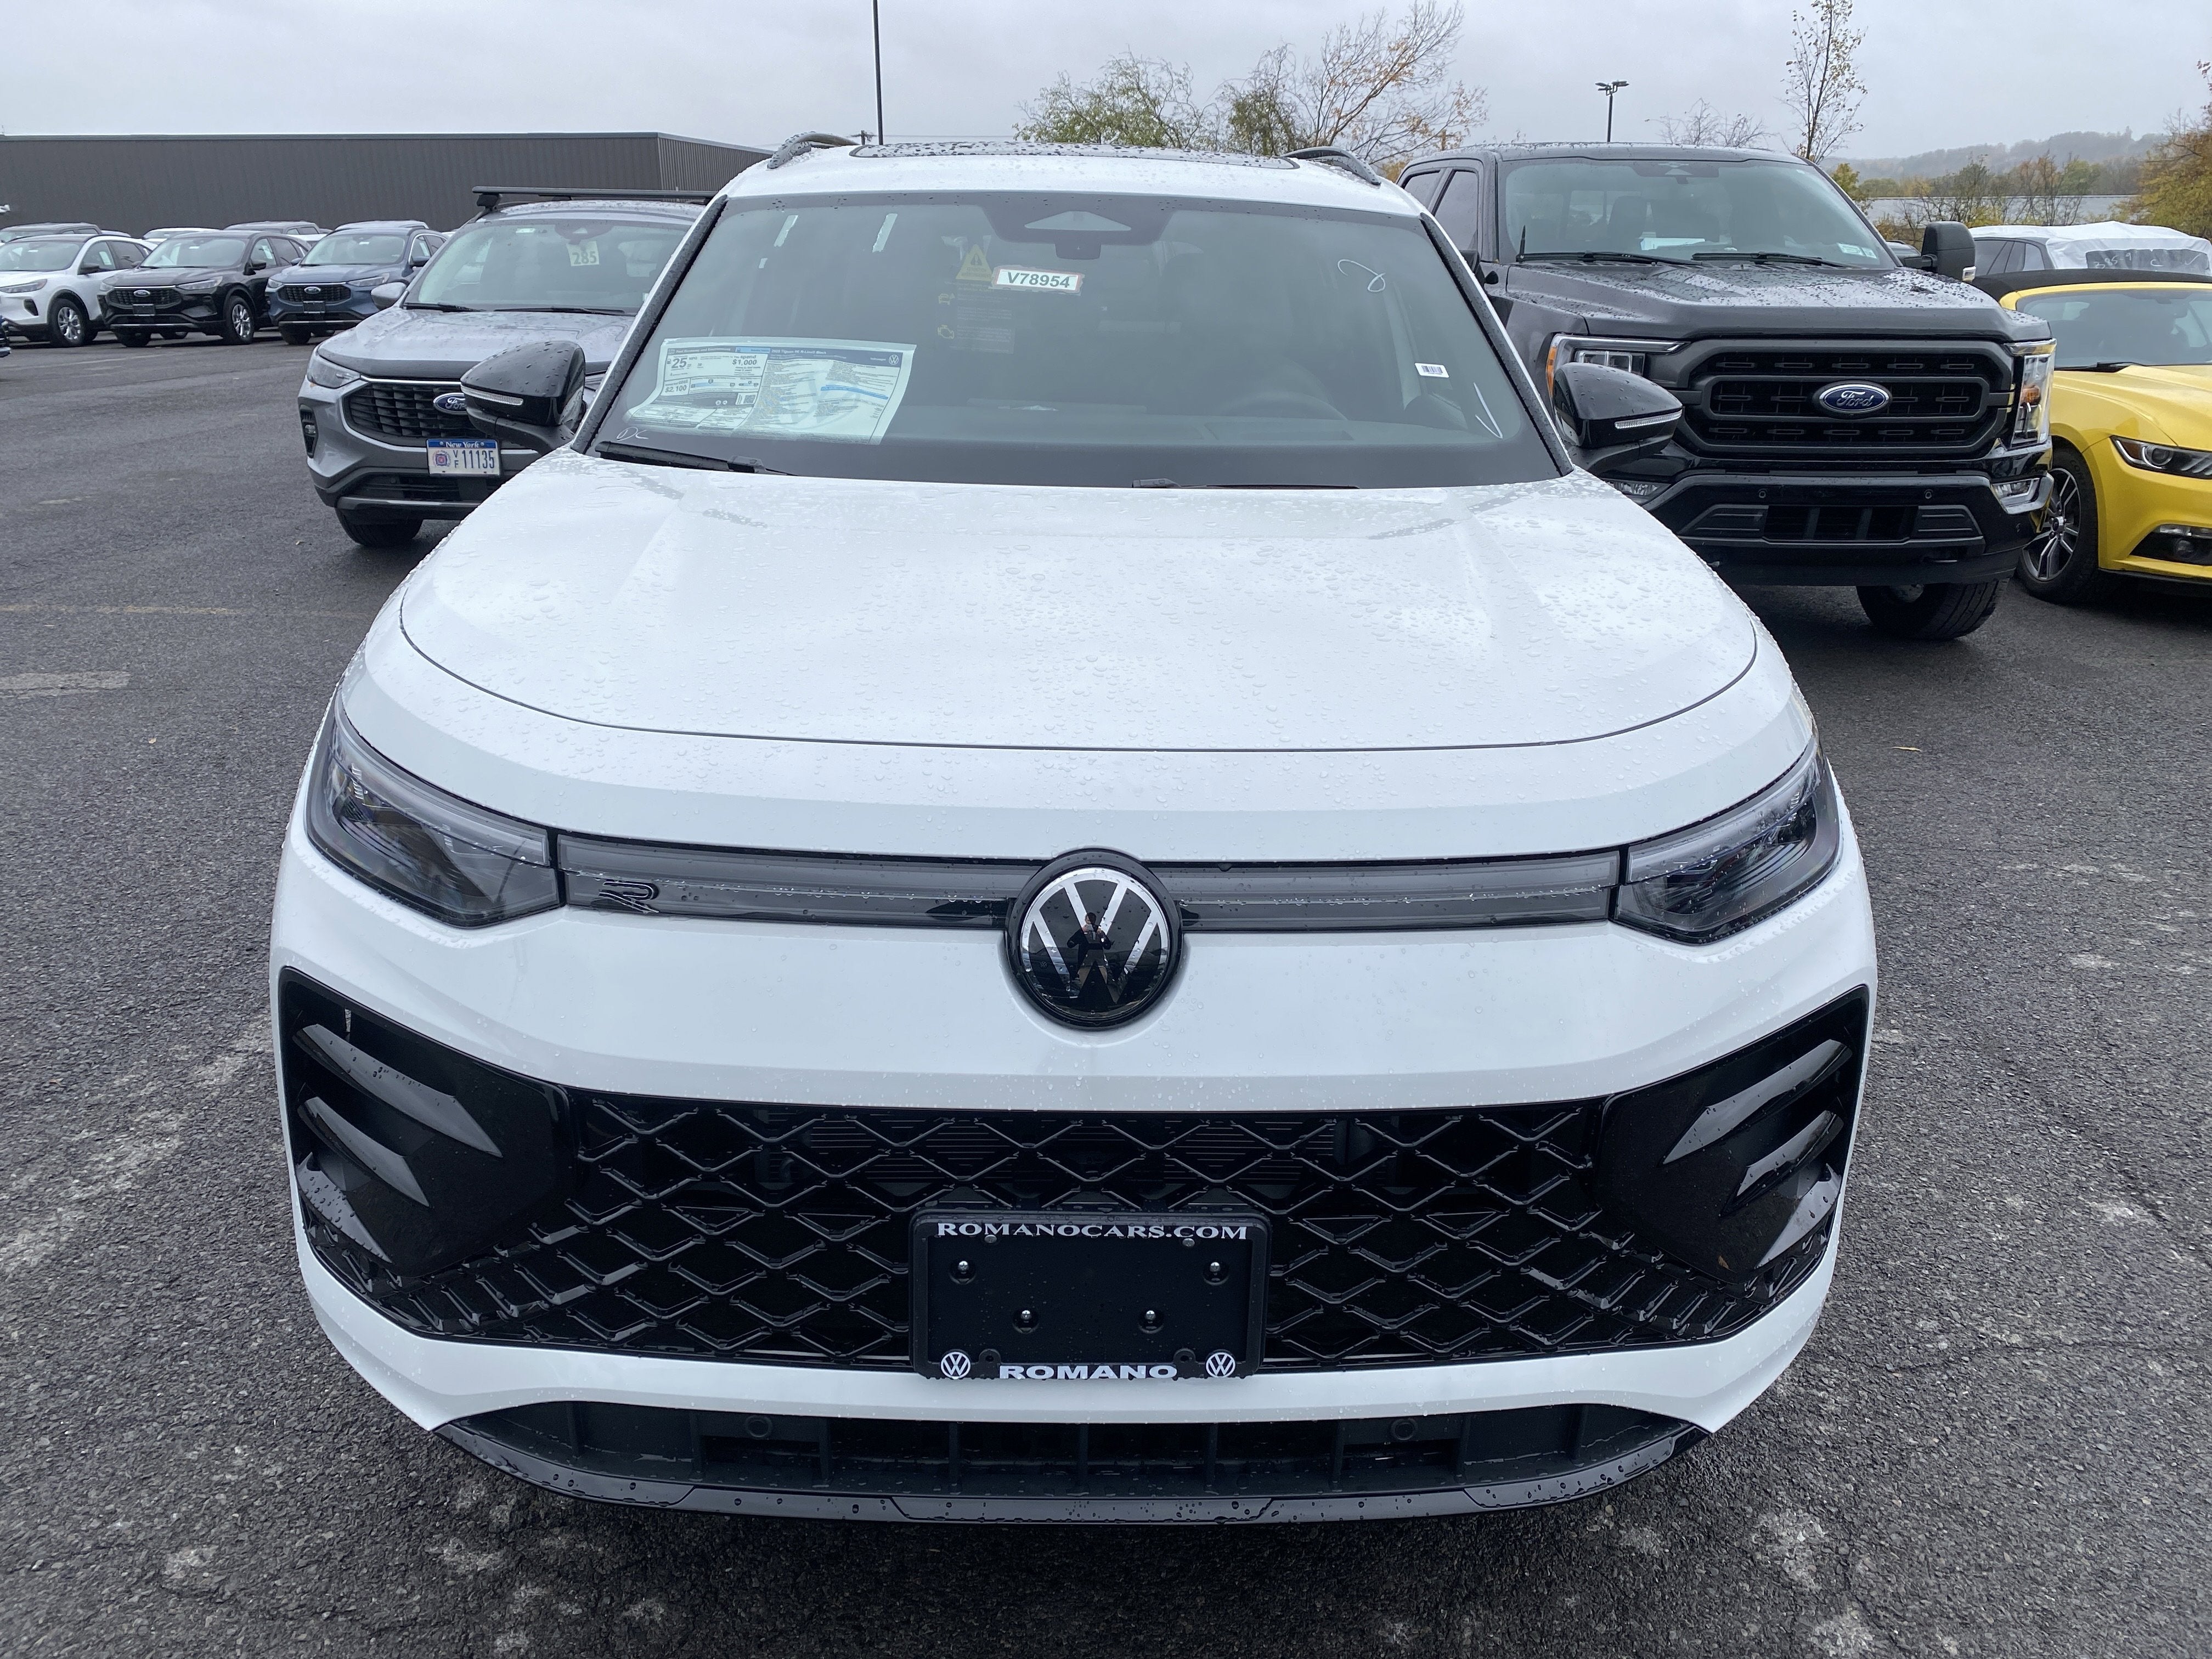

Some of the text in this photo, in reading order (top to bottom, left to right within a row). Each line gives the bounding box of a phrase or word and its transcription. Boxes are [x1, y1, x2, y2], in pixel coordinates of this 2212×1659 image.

[572, 251, 597, 264] 285
[1007, 272, 1070, 288] V78954
[671, 357, 687, 369] 25
[1837, 390, 1875, 407] Ford
[461, 449, 494, 469] 11135
[937, 1222, 1247, 1240] ROMANOCARS.COM
[999, 1364, 1177, 1380] ROMANO
